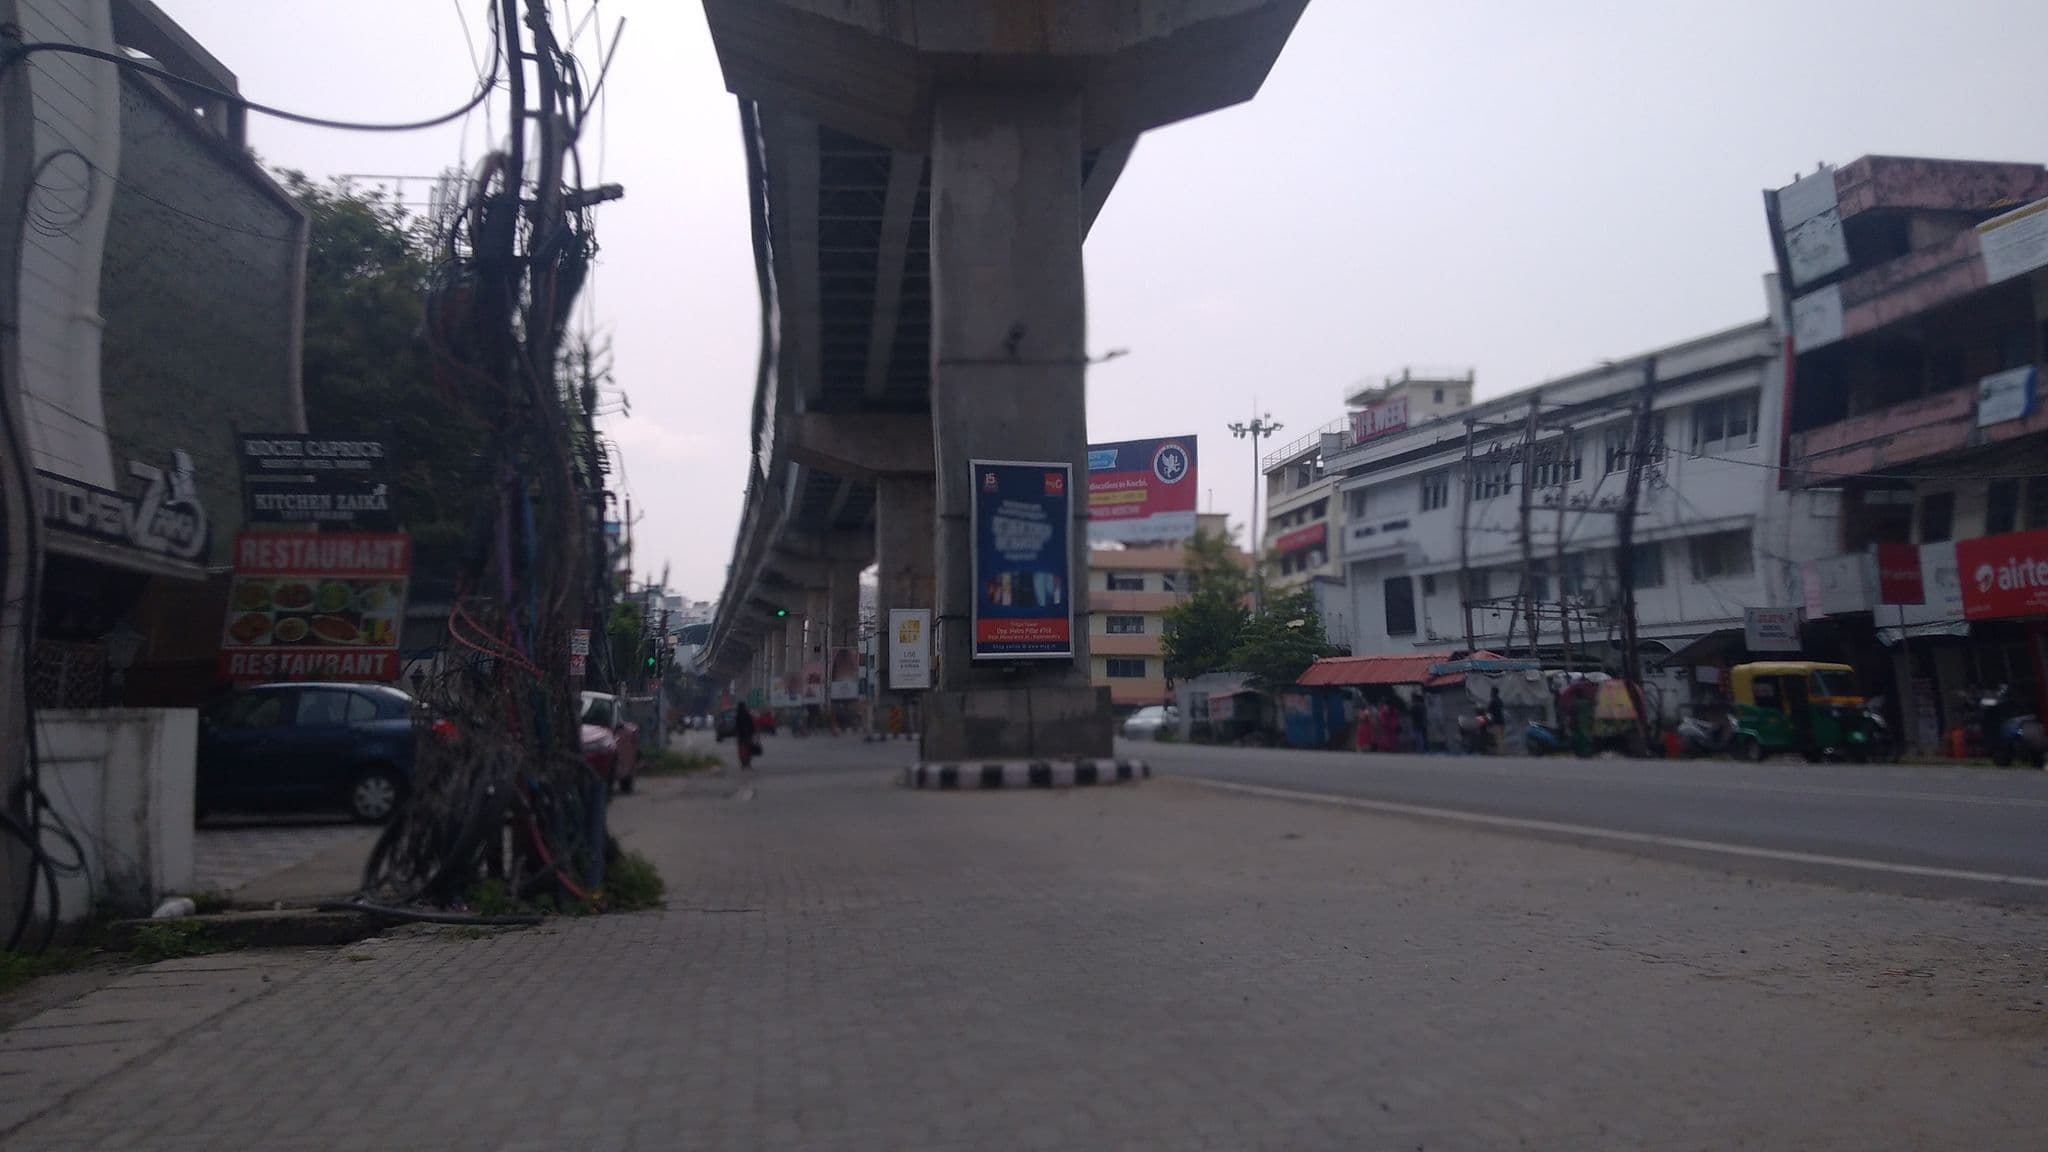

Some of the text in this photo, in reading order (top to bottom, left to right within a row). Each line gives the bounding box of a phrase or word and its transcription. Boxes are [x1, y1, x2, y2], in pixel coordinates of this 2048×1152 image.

[255, 495, 331, 510] KITCHEN
[240, 538, 405, 569] RESTAURANT
[230, 653, 389, 675] RESTAURANT
